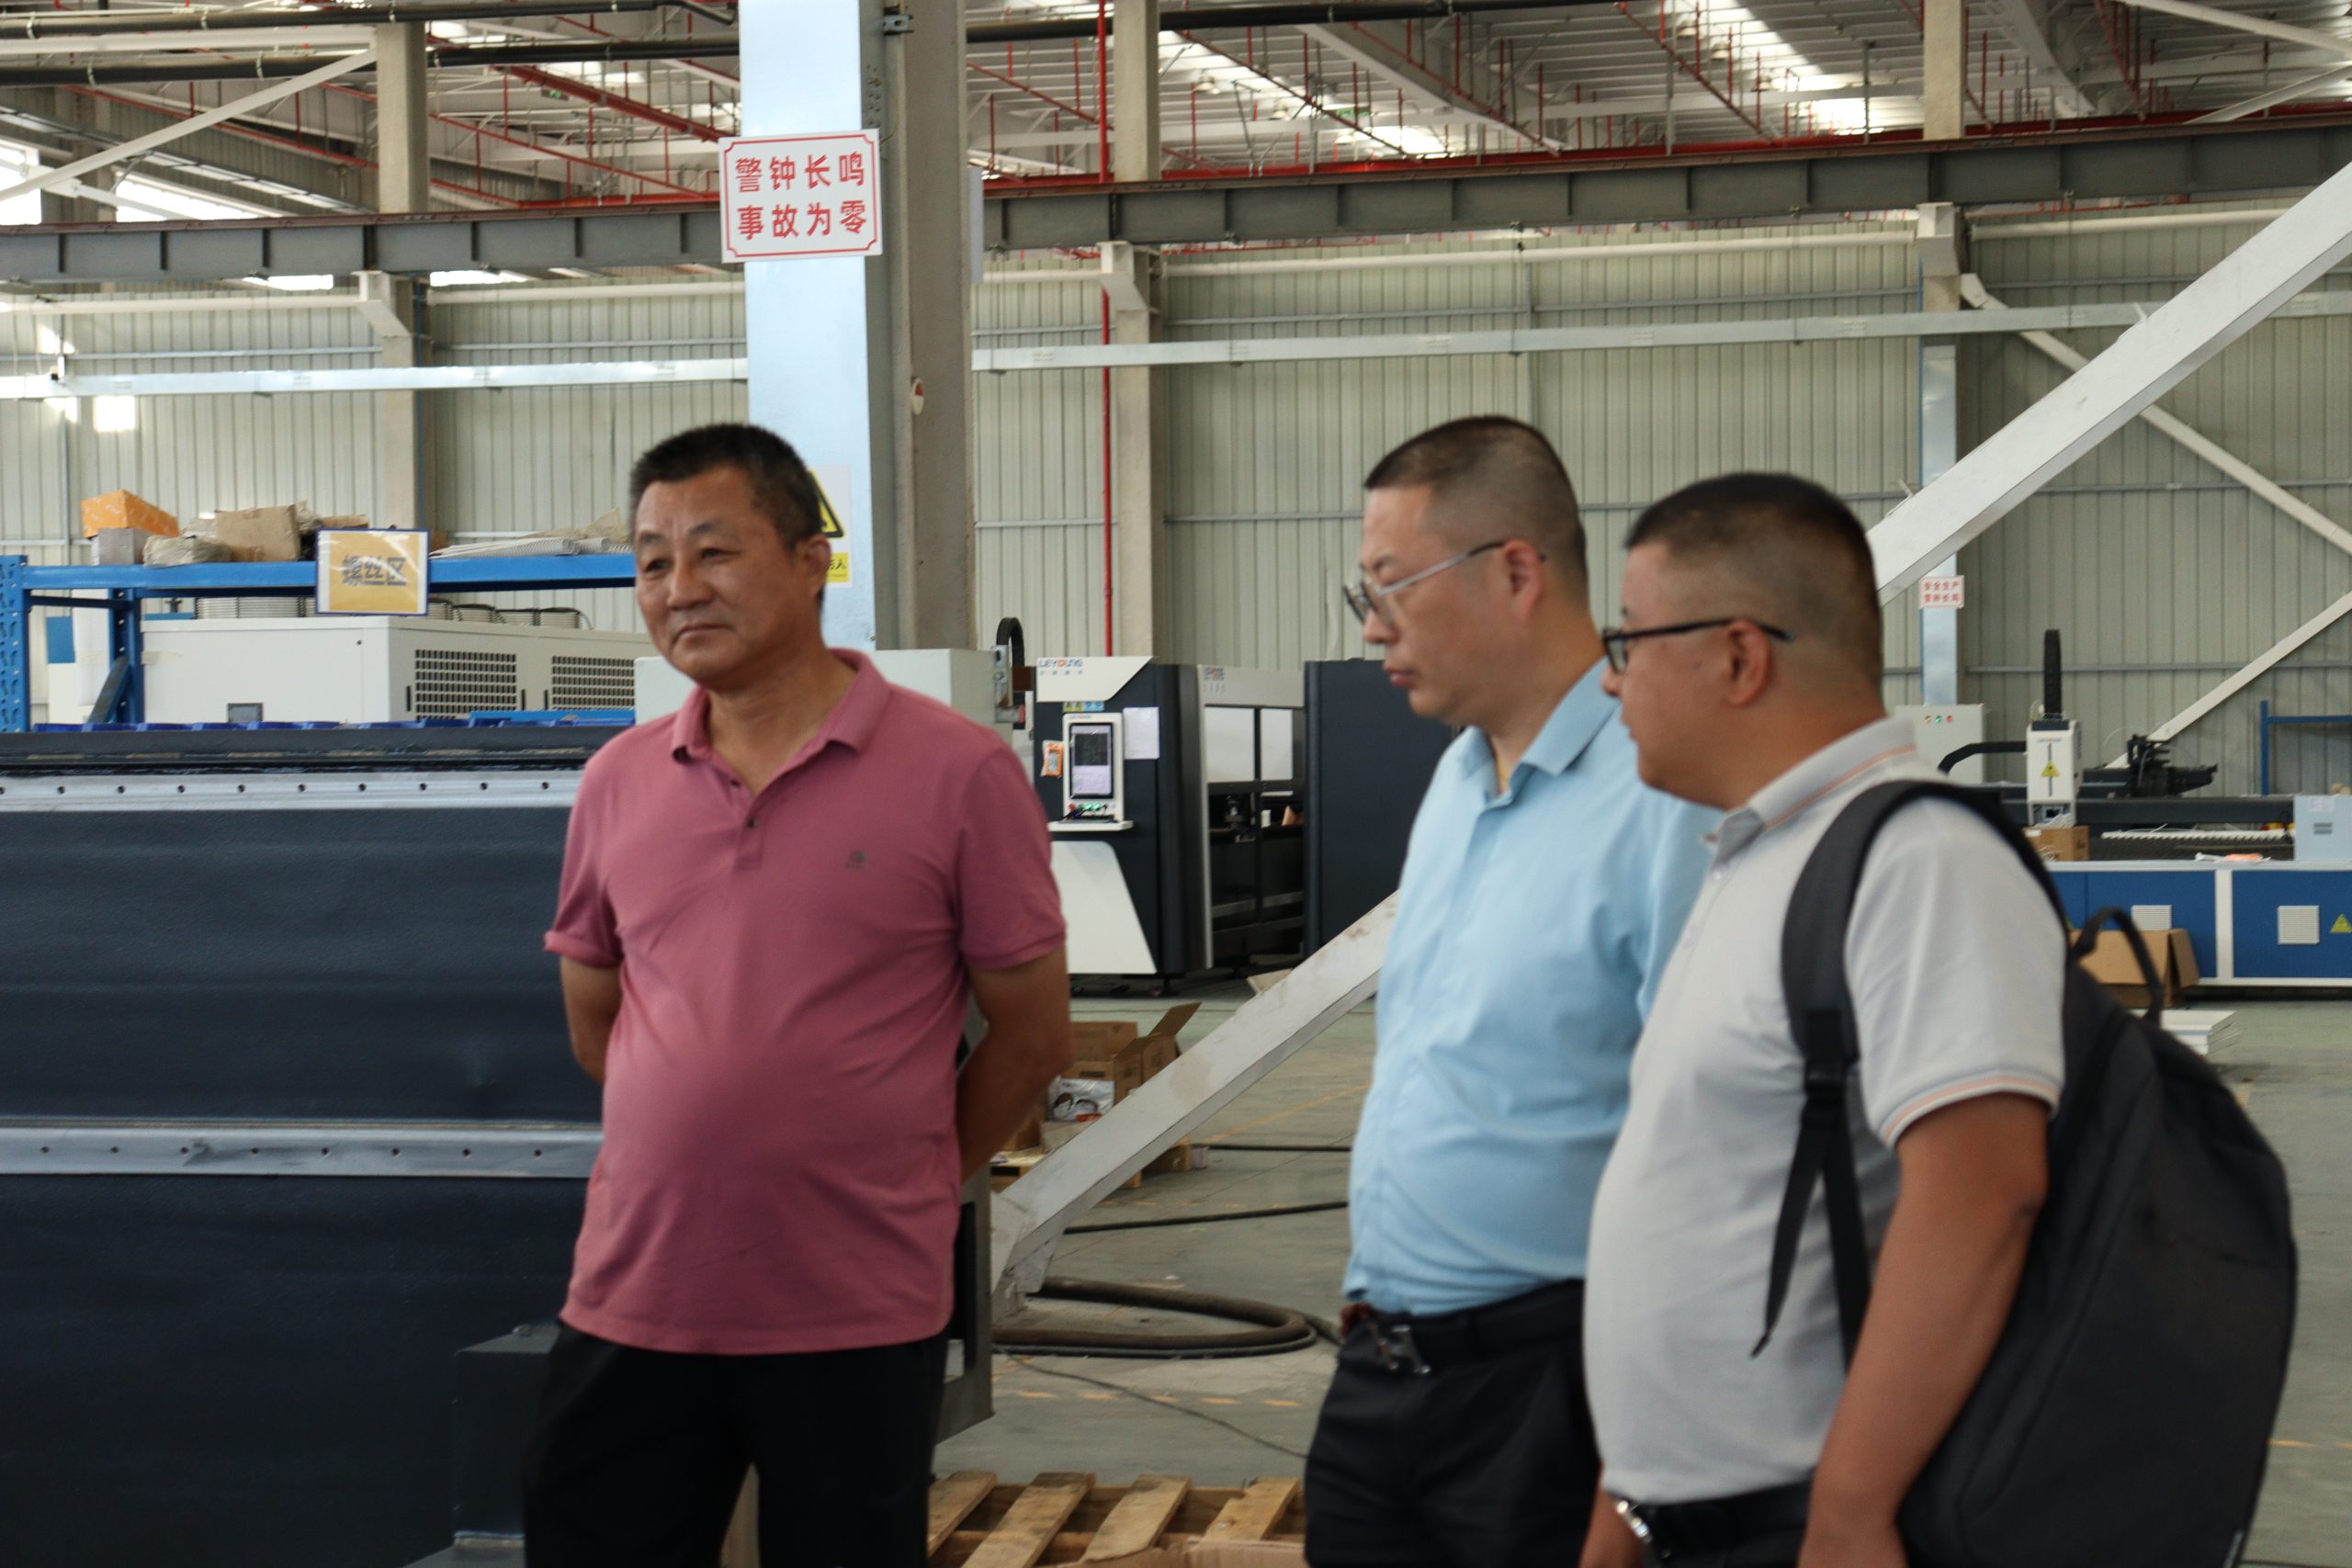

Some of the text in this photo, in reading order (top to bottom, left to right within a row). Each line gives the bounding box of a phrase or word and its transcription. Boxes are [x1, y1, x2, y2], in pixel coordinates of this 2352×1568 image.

[735, 152, 865, 193] 警钟长鸣
[737, 199, 867, 241] 事故为零
[342, 555, 407, 586] 螺丝区
